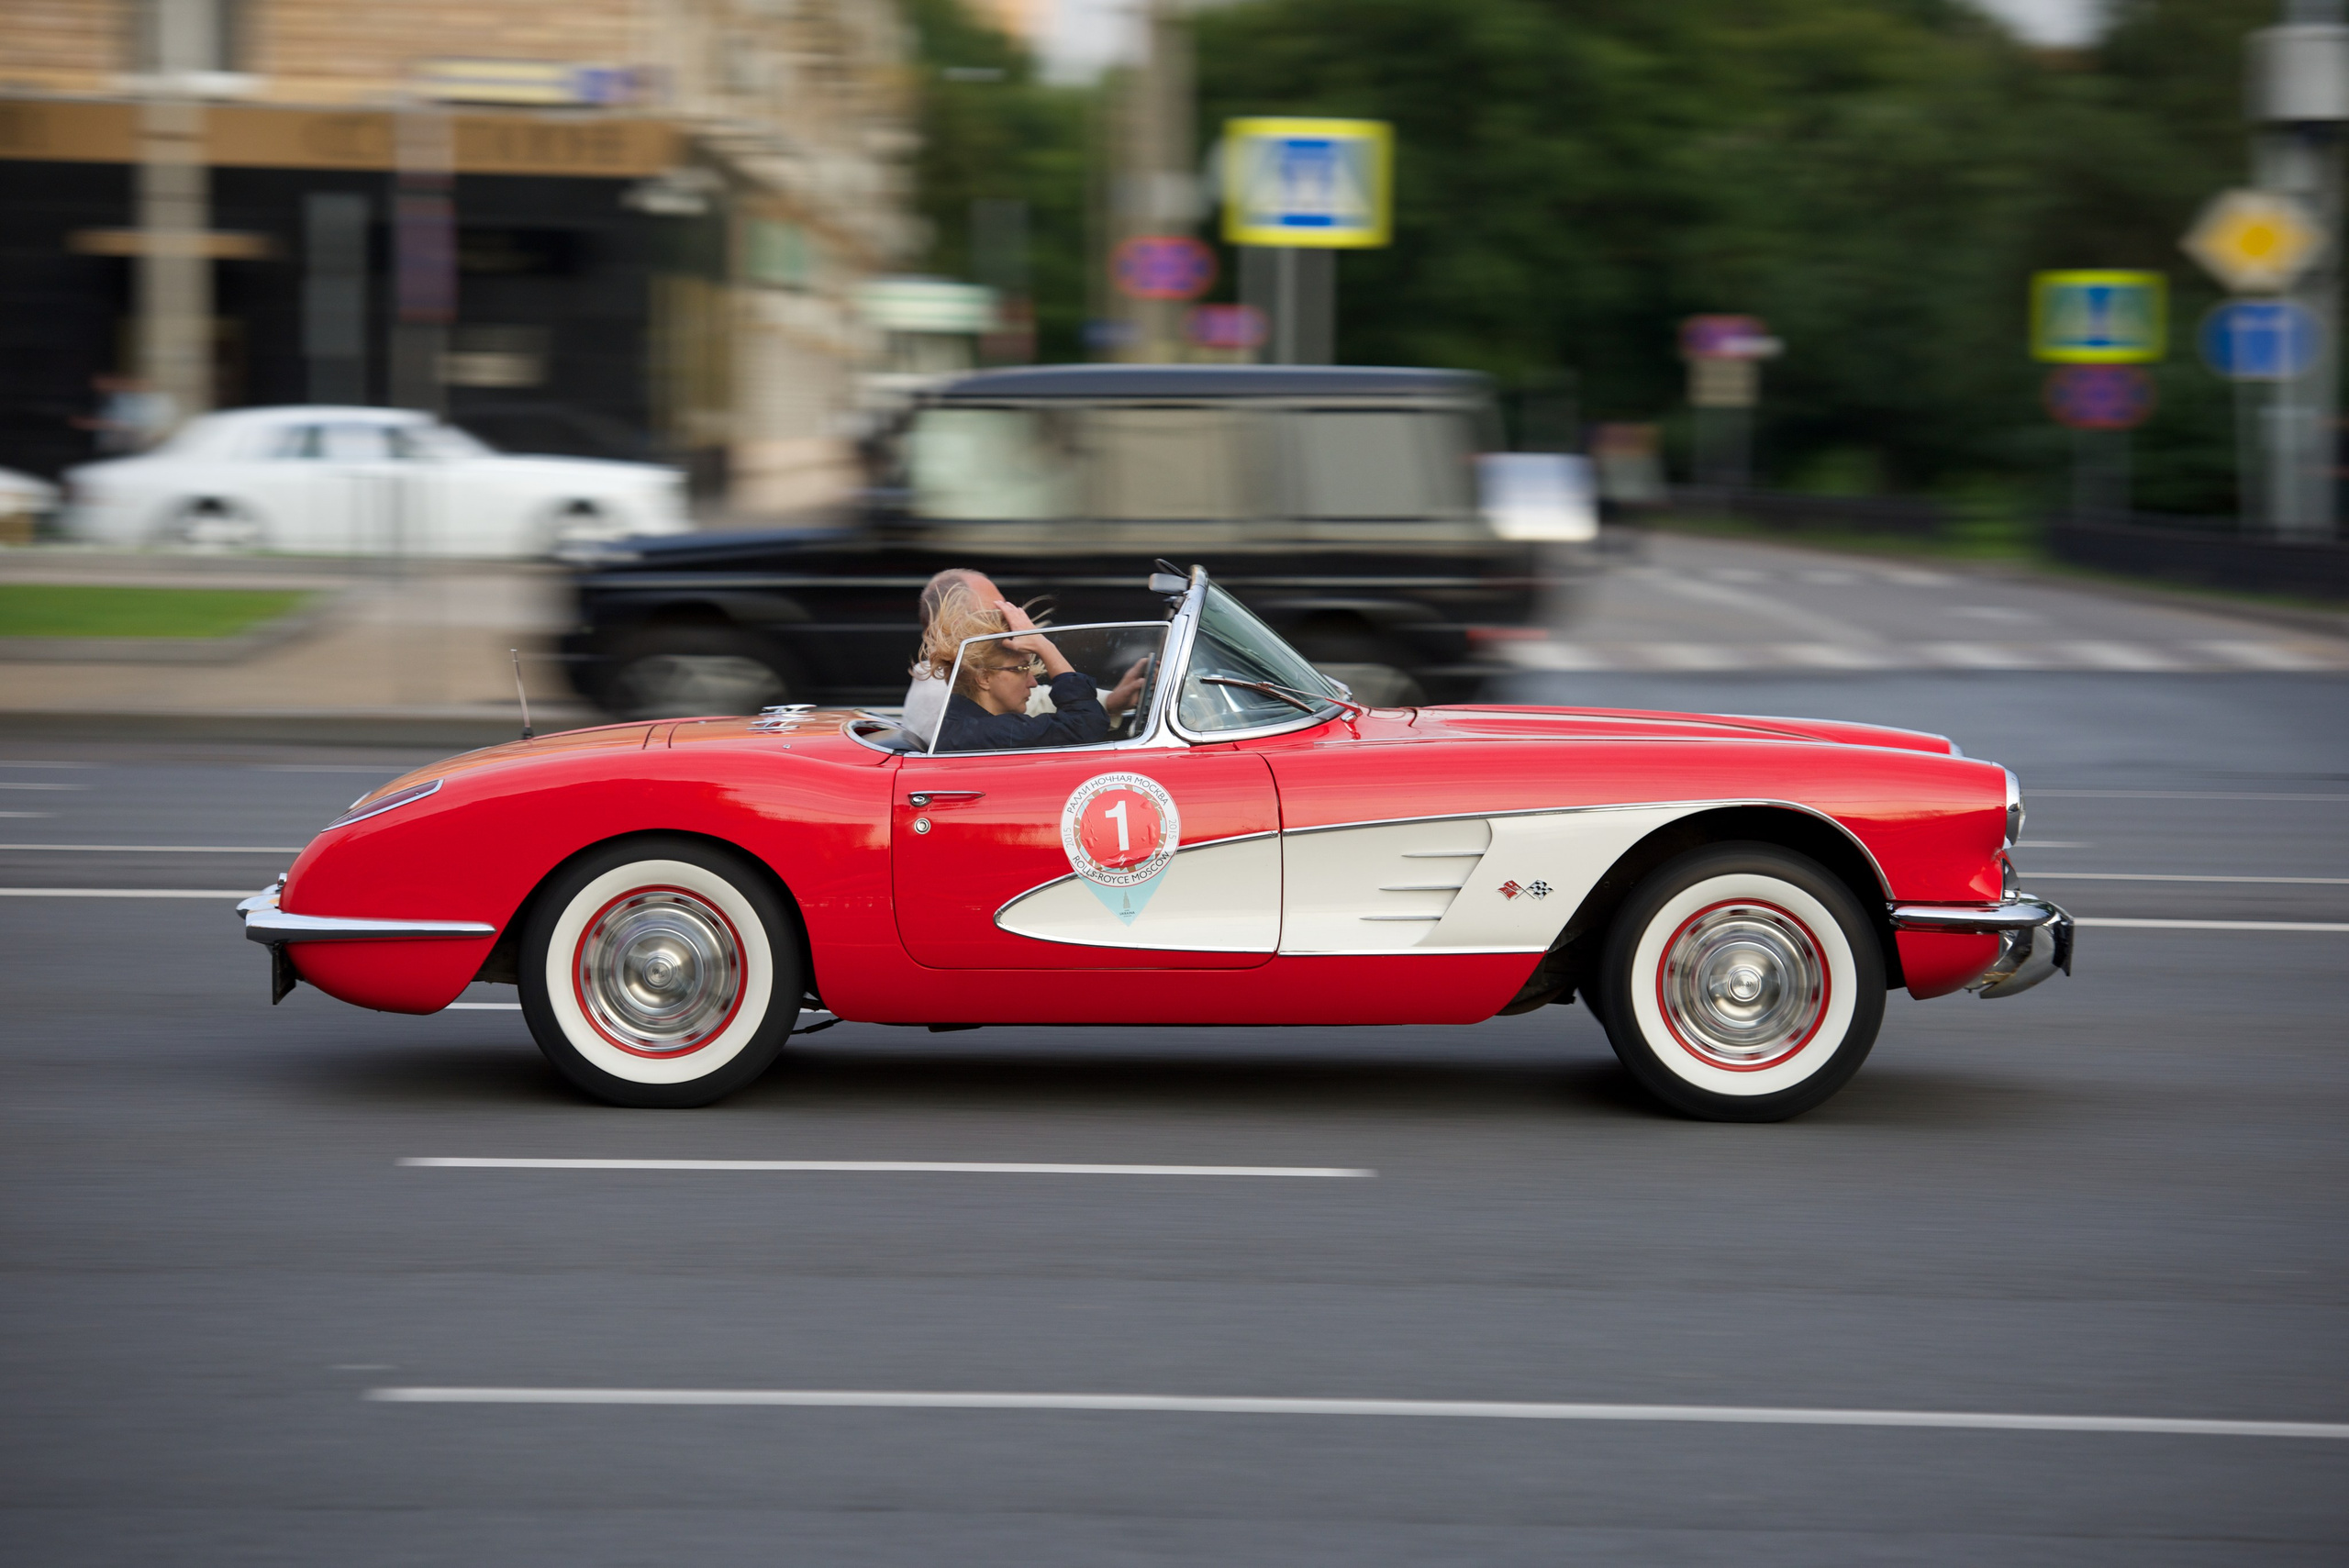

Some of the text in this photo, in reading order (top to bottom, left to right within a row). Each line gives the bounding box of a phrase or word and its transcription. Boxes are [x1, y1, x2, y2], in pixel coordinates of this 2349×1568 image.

[1066, 774, 1169, 814] РАЛЛИ НОЧНАЯ МОСКВА
[1063, 827, 1074, 848] 2015
[1105, 800, 1130, 851] 1
[1168, 818, 1178, 840] 2015
[1072, 850, 1170, 884] ROLLS-ROYCE MOSCOW
